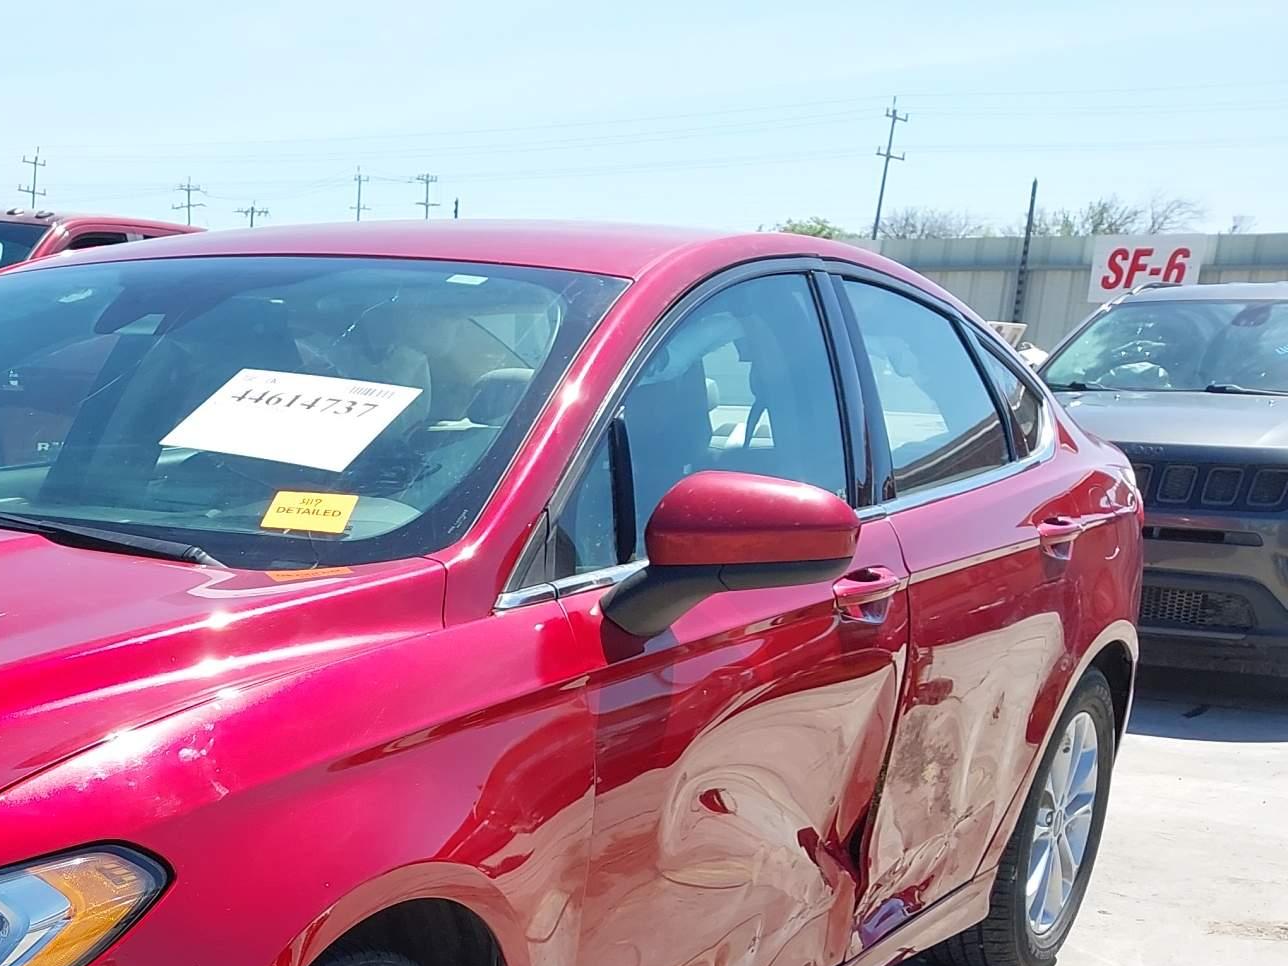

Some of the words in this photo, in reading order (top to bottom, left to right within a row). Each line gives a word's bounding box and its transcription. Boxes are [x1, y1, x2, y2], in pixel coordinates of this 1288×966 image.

[1101, 247, 1191, 290] SF-6
[231, 388, 379, 418] 44614737
[275, 506, 342, 517] DETAILED
